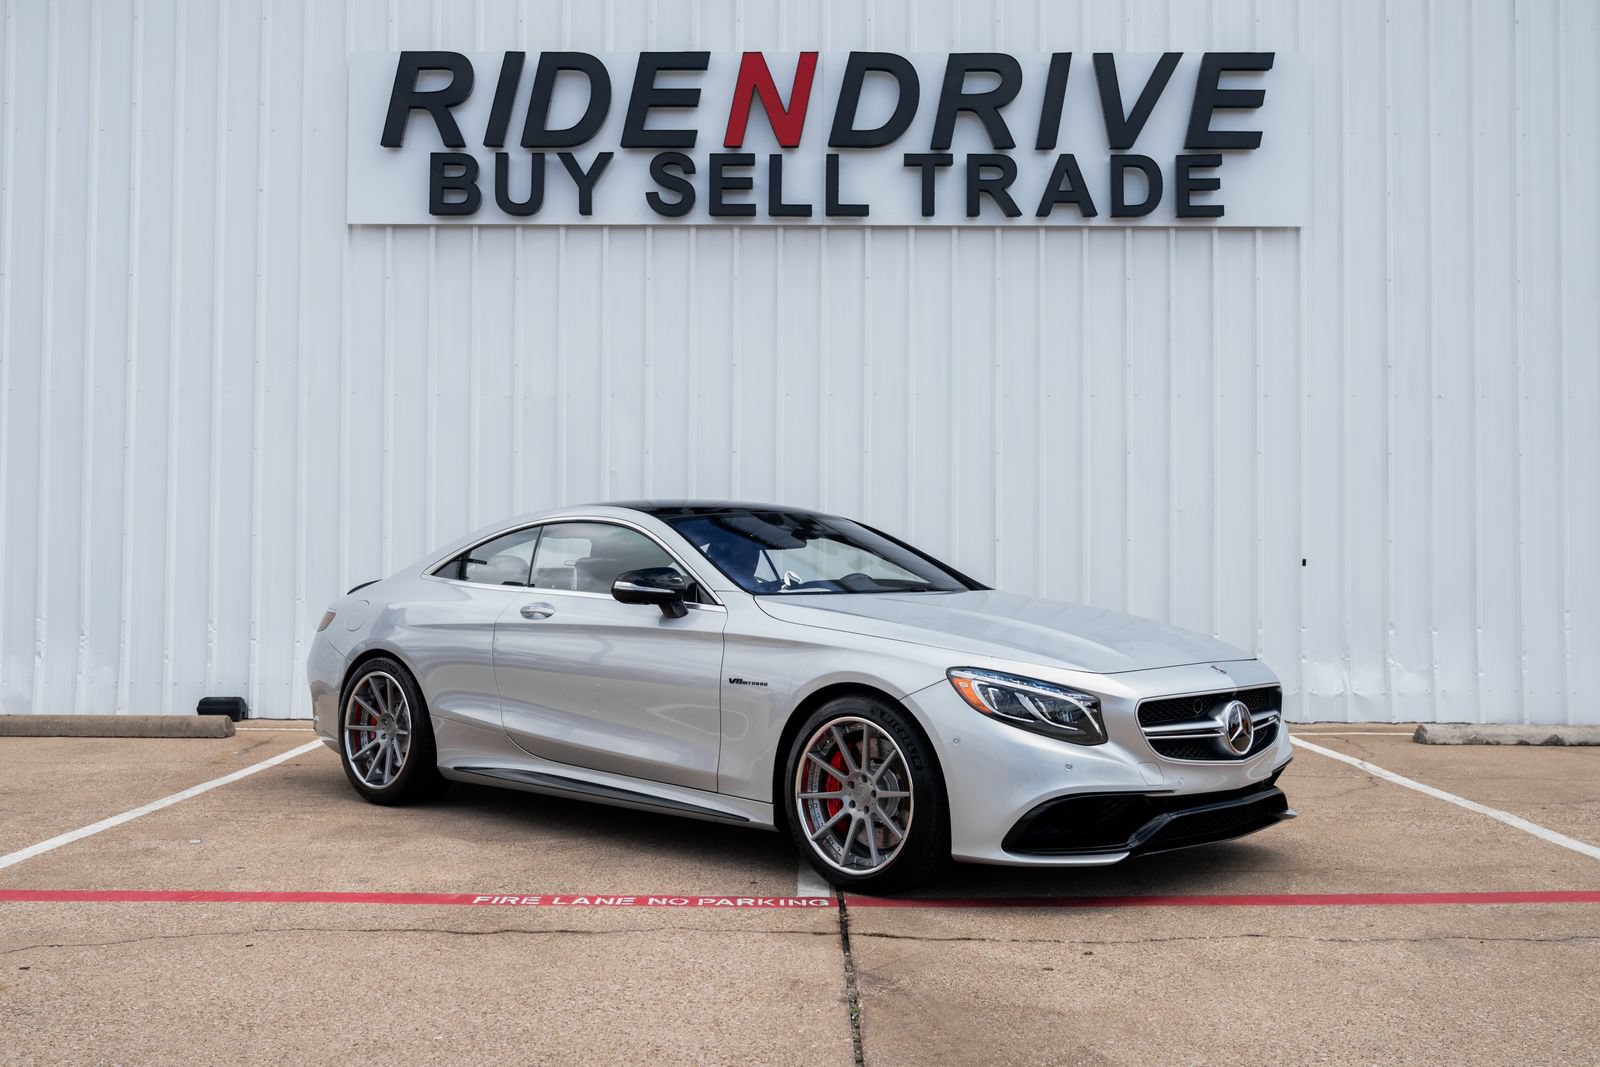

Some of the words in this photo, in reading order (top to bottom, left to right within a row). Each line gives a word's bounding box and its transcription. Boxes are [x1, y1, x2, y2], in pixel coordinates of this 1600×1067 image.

[429, 152, 614, 217] BUY
[645, 151, 869, 217] SELL
[904, 153, 1224, 218] TRADE
[472, 896, 540, 905] FIRE
[552, 896, 635, 906] LANE
[647, 897, 689, 906] NO
[697, 898, 830, 907] PARKING
